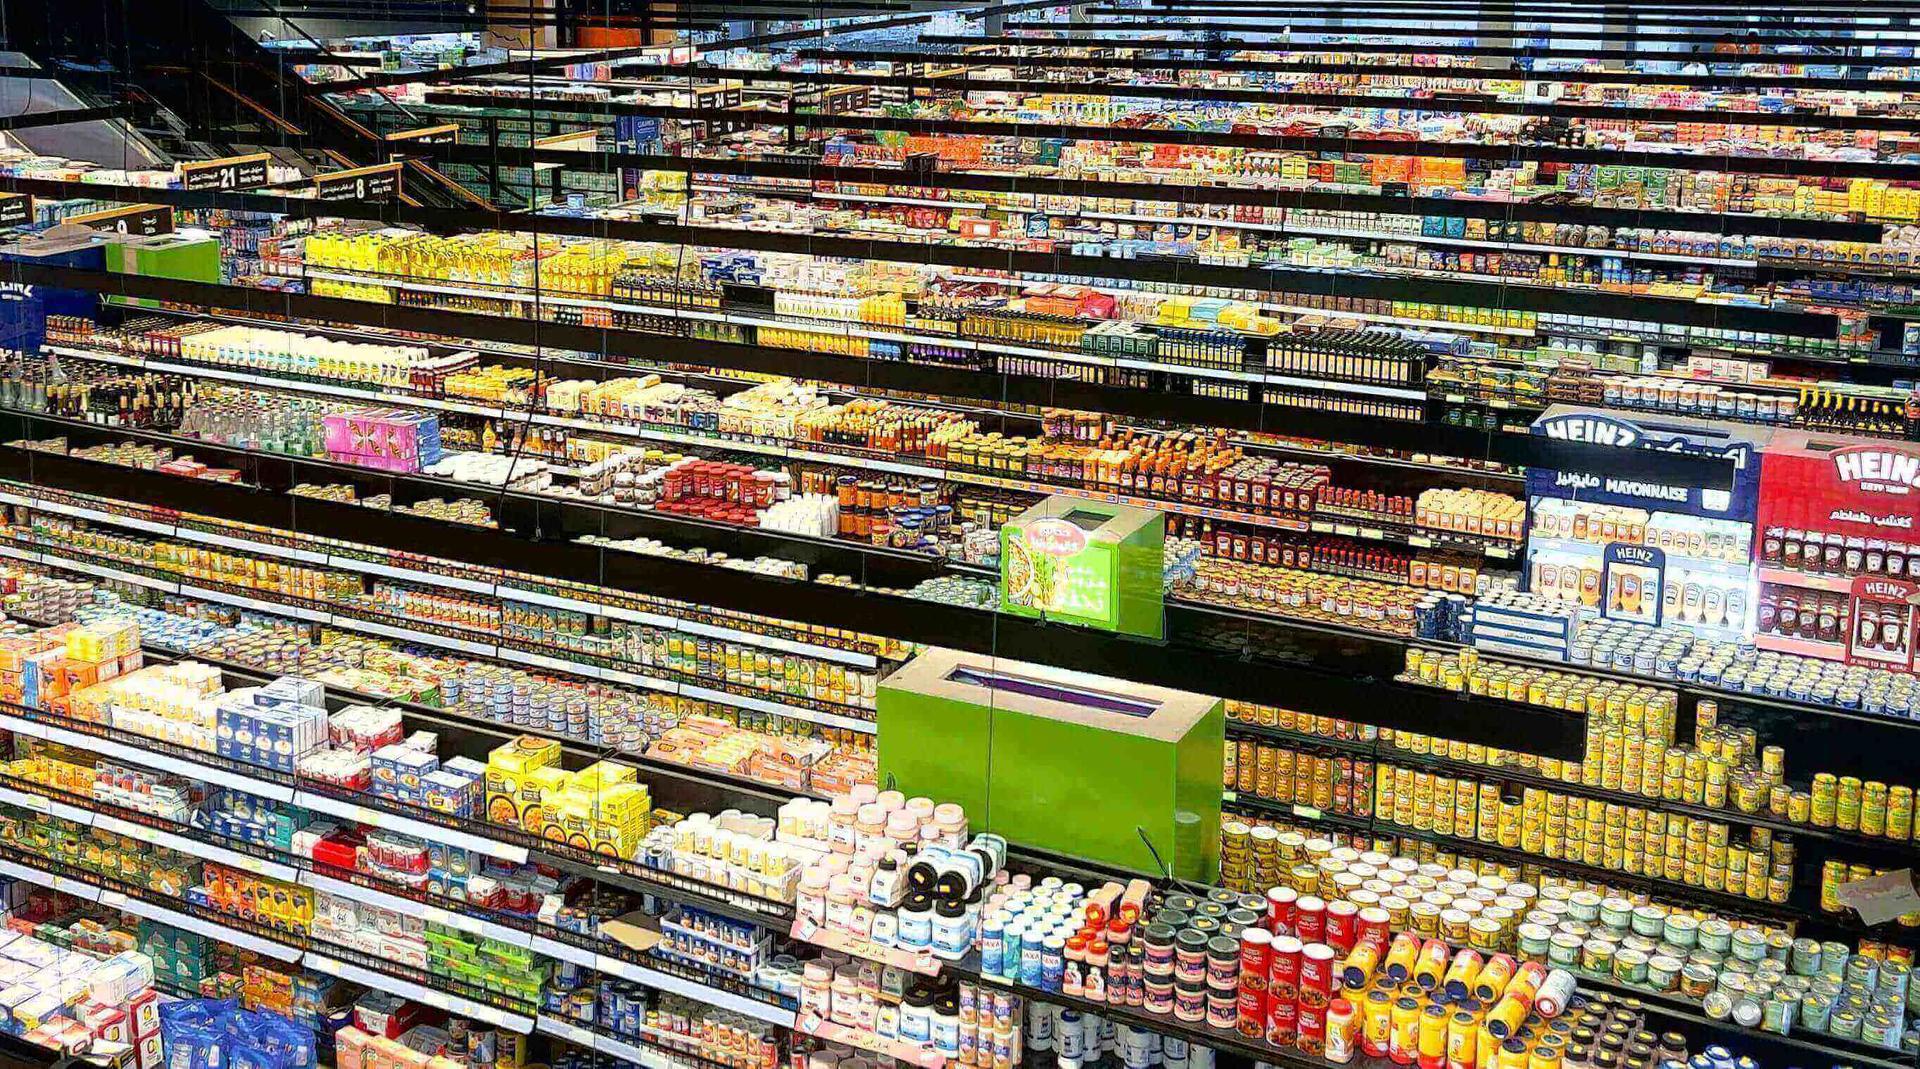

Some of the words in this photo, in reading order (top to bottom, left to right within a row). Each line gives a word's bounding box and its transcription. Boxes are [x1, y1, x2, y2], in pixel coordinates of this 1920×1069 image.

[220, 167, 236, 188] 21
[356, 178, 365, 199] 8
[1834, 451, 1920, 488] HEIN
[1605, 478, 1688, 503] MAYONNAISE
[1616, 547, 1654, 563] HEINZ
[1865, 582, 1907, 599] HEINZ
